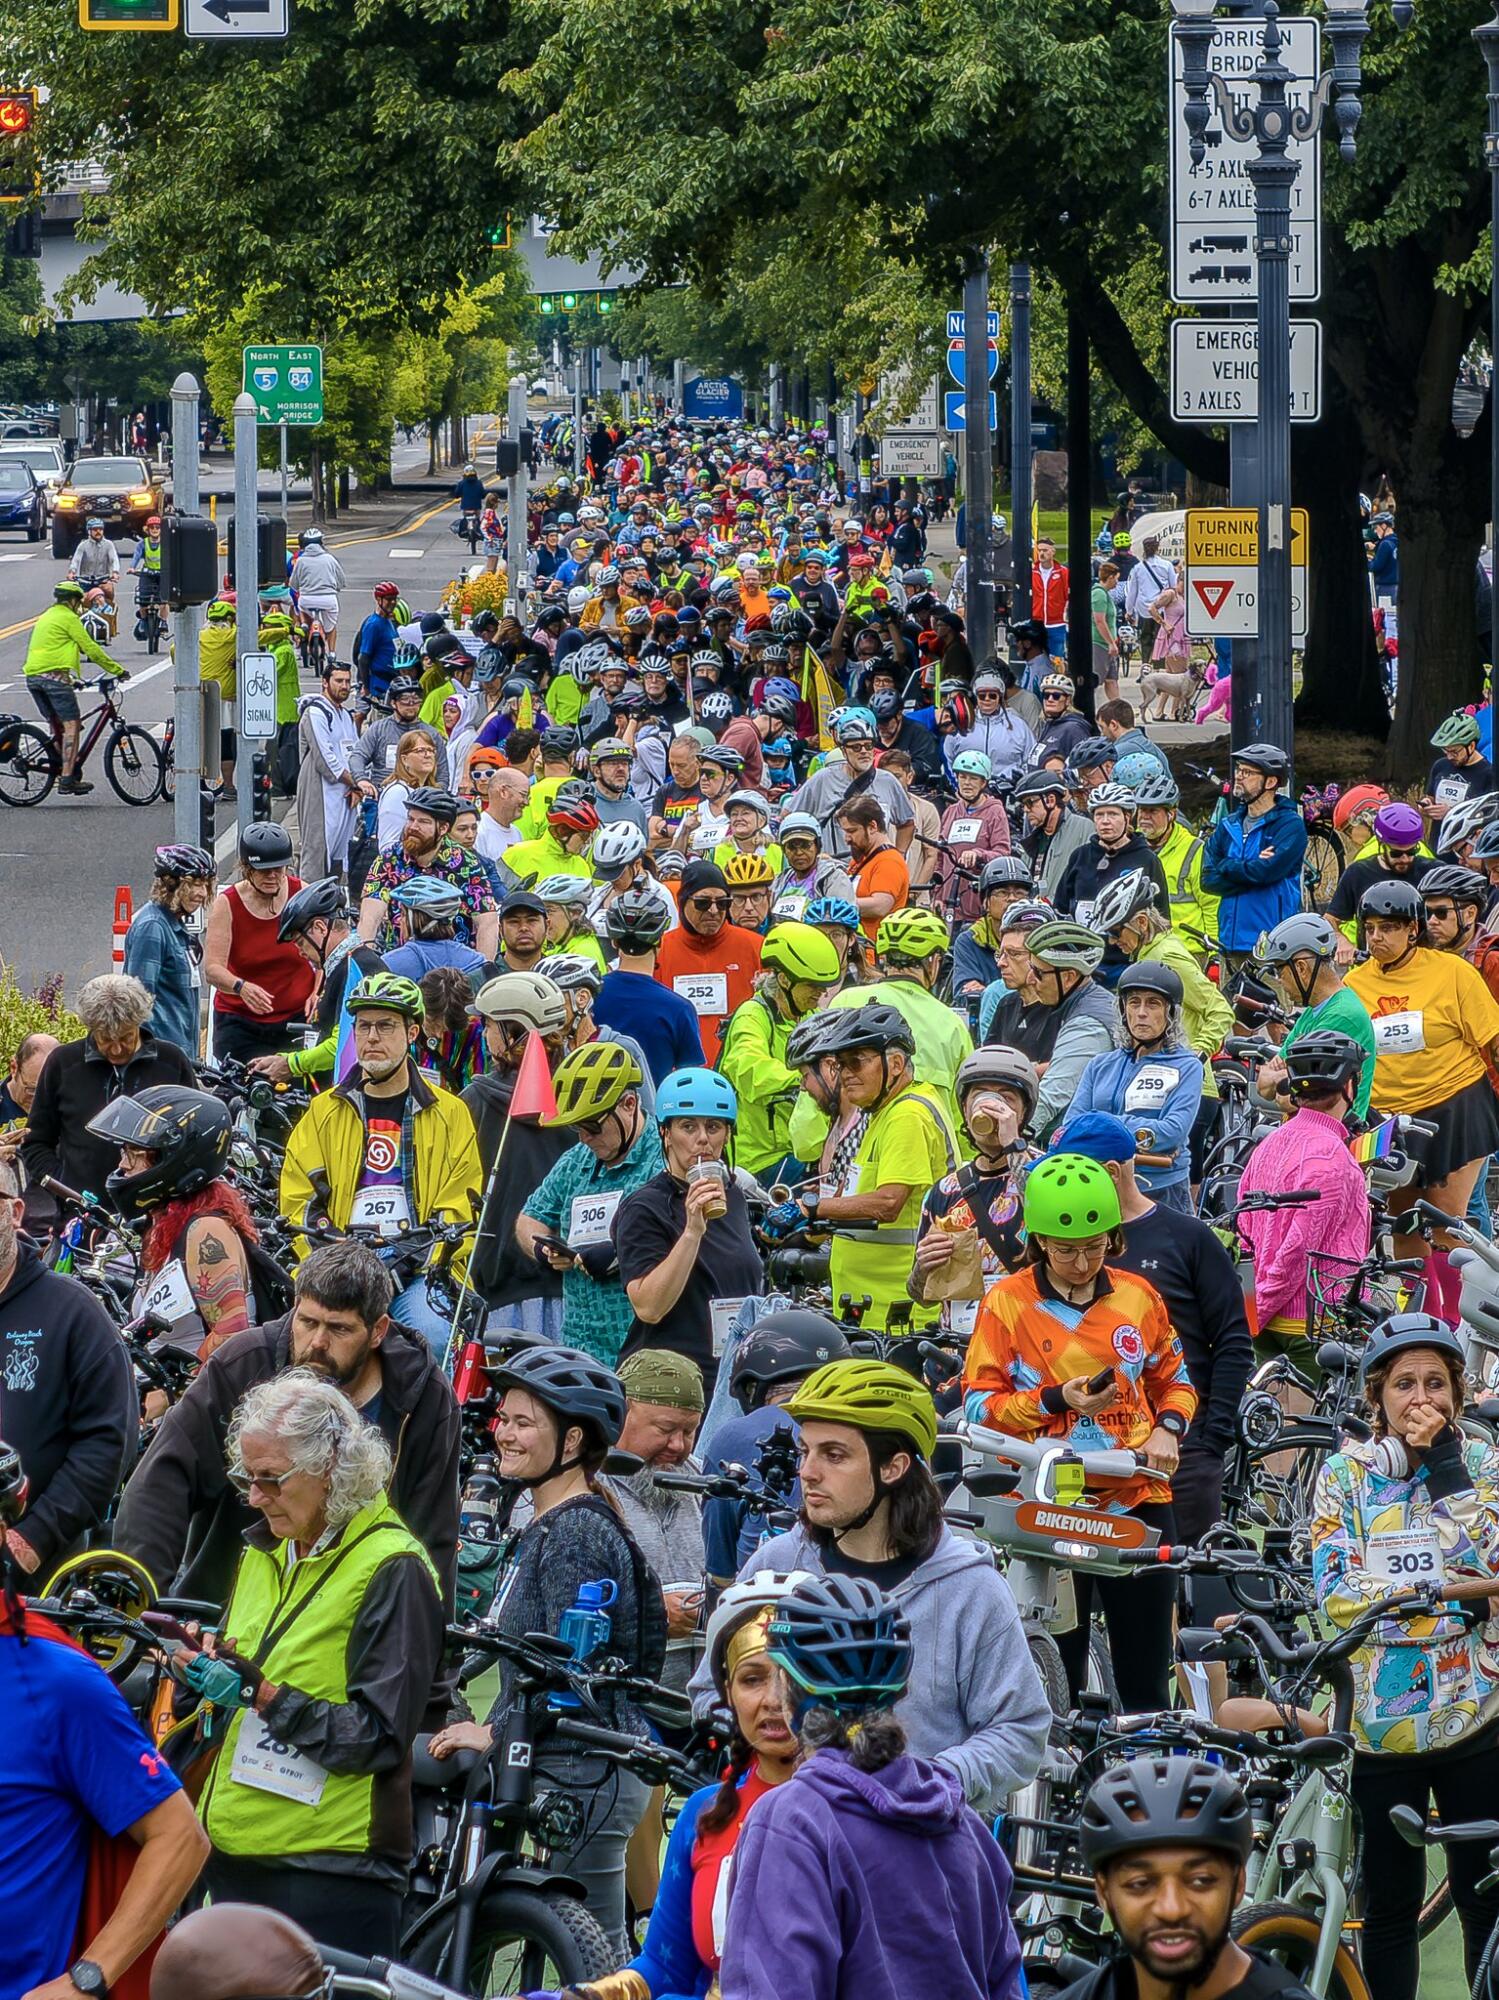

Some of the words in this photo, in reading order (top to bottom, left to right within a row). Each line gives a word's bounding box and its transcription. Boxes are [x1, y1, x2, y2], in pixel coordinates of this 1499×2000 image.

[1211, 29, 1292, 47] ORRISN
[1188, 190, 1213, 209] 6-7
[1218, 189, 1258, 208] AXLE
[1196, 331, 1297, 350] EMERGEY
[288, 350, 312, 360] EAST
[1212, 361, 1259, 380] VEHIC
[262, 374, 271, 388] 5
[291, 373, 309, 386] 84
[695, 388, 730, 396] GLACIER
[277, 402, 319, 410] MORRISON
[1183, 391, 1191, 410] 3
[1198, 391, 1242, 410] AXLES
[1302, 392, 1310, 410] T
[889, 440, 931, 449] EMERGENCY
[896, 452, 925, 461] VEHICLE
[1194, 543, 1257, 557] VEHICLE
[1236, 592, 1255, 608] TO
[247, 709, 272, 722] SIGNAL
[779, 904, 796, 914] 230
[687, 986, 714, 998] 252
[1383, 1023, 1410, 1038] 253
[1136, 1078, 1164, 1090] 259
[364, 1200, 396, 1216] 267
[581, 1206, 606, 1224] 306
[147, 1284, 172, 1312] 302
[1034, 1510, 1114, 1538] BIKETOWN
[1386, 1551, 1434, 1574] 303
